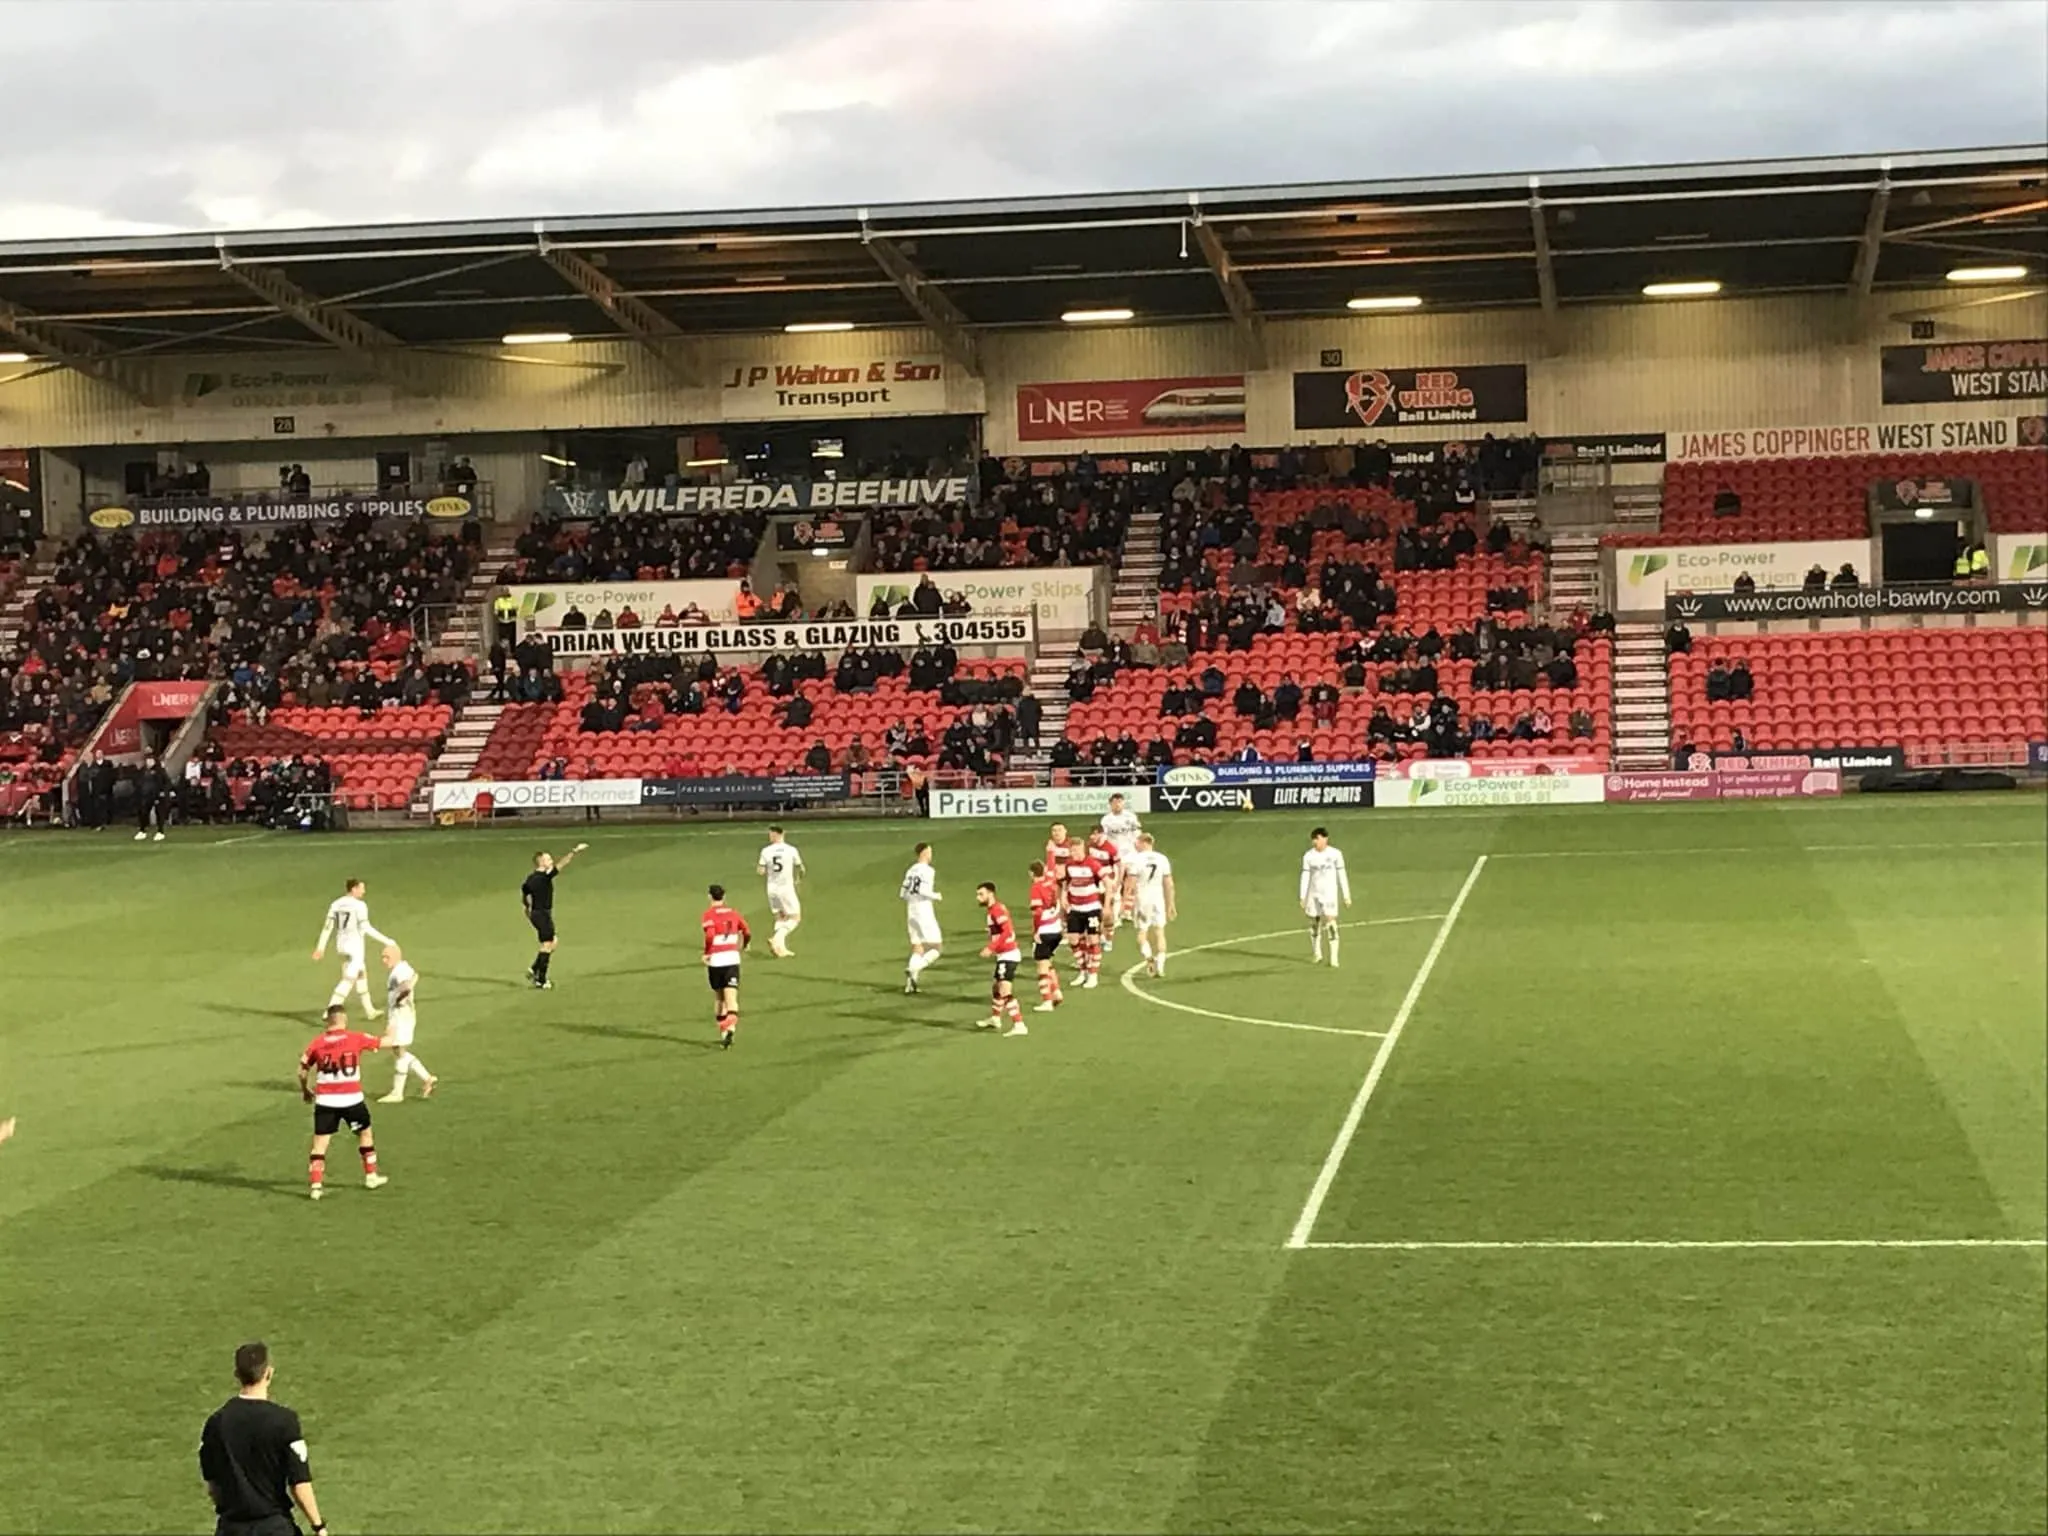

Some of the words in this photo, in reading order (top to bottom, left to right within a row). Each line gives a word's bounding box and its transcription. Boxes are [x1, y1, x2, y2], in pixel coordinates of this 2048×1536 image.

[725, 367, 742, 388] J
[748, 366, 768, 387] P
[775, 364, 860, 386] Walton
[867, 362, 885, 382] &
[894, 360, 941, 381] Son
[1415, 371, 1457, 390] RED
[1952, 371, 2002, 396] WEST
[776, 387, 890, 407] Transport
[1399, 388, 1473, 408] VIKING
[1029, 398, 1104, 425] LNER
[1399, 410, 1425, 422] Rail
[1428, 408, 1477, 421] Limited
[276, 418, 293, 432] 28
[1678, 431, 1746, 459] JAMES
[1752, 427, 1870, 457] COPPINGER
[1878, 423, 1935, 449] WEST
[1942, 420, 2007, 447] STAND
[1609, 443, 1662, 457] Limited
[810, 477, 968, 507] BEEHIVE
[138, 506, 224, 525] BUILDING
[229, 506, 242, 522] &
[247, 502, 341, 522] PLUMBING
[344, 500, 424, 517] SPPLIES
[1677, 551, 1776, 569] Eco-Power
[564, 589, 656, 605] Eco-Power
[1031, 581, 1083, 601] Skips
[1725, 588, 2000, 613] www.crownhotel-bawtry.com
[547, 633, 615, 652] DRIAN
[622, 630, 698, 650] WELCH
[711, 628, 776, 648] GLASS
[783, 629, 799, 645] &
[805, 623, 900, 645] GLAZING
[934, 619, 1027, 641] 304555
[1218, 765, 1263, 777] BUILDING
[1265, 765, 1273, 775] &
[1275, 764, 1324, 775] PLUMBING
[1326, 762, 1371, 774] SUPPLIES
[1841, 755, 1893, 768] Limited
[1444, 779, 1524, 792] Eco-Power
[1624, 777, 1660, 789] Home
[1663, 775, 1709, 788] Instead
[477, 784, 577, 806] OOBER
[579, 782, 635, 802] homes
[940, 792, 1048, 815] Pristine
[1274, 787, 1298, 805] ELITE
[1323, 785, 1361, 804] SPORTS
[771, 854, 783, 873] 5
[1146, 863, 1157, 882] 7
[333, 911, 351, 929] 17
[318, 1052, 357, 1079] 40
